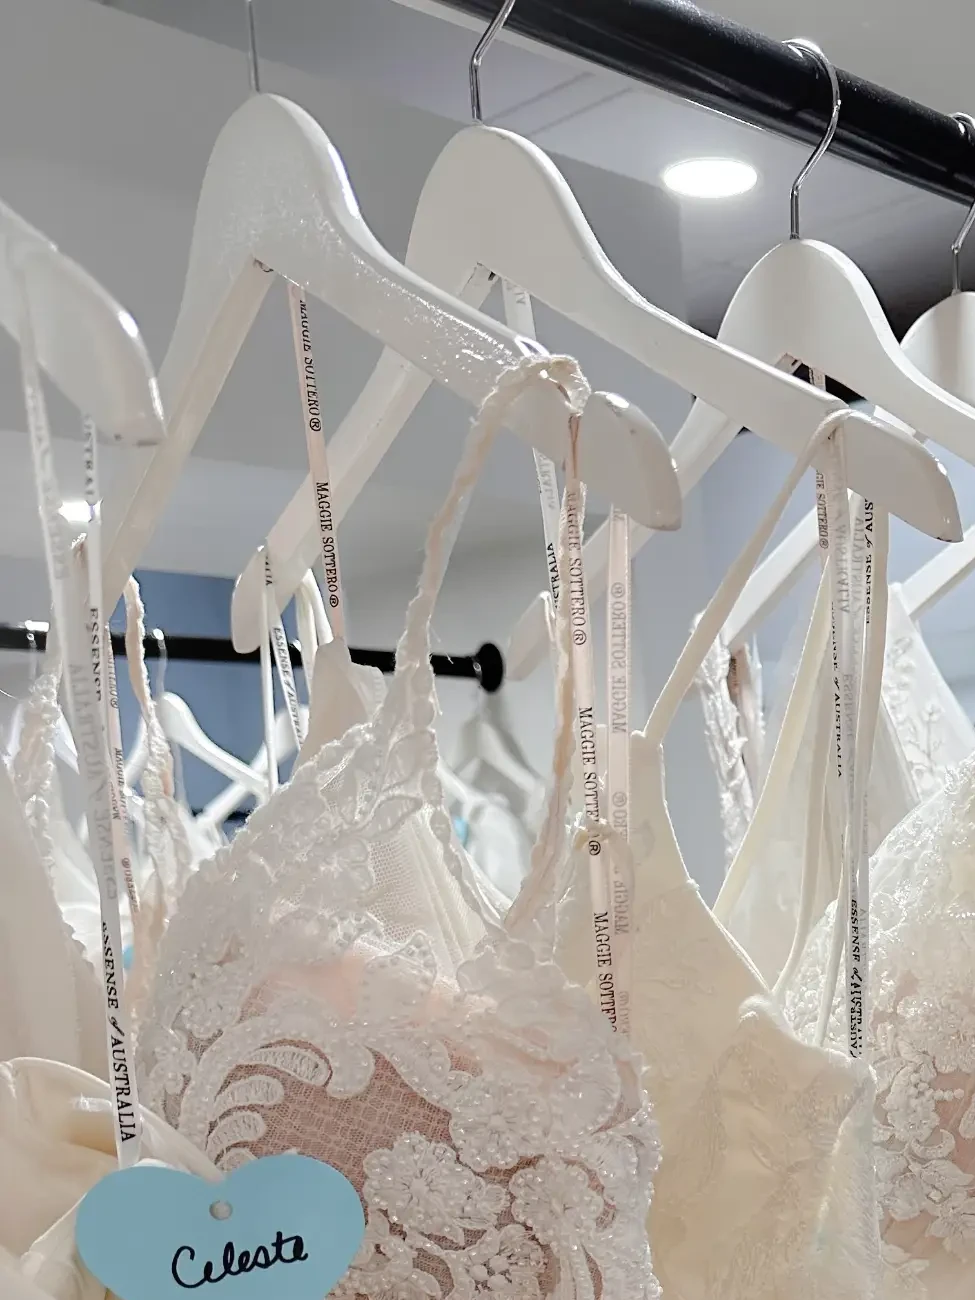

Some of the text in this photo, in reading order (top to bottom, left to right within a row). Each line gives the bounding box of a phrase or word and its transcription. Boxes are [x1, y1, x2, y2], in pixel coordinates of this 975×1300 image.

[316, 482, 340, 608] MAGGIE SOTTERO®
[578, 705, 597, 766] MAGGIE
[594, 911, 613, 967] MAGGIE
[110, 1033, 137, 1143] AUSTRALIA
[171, 1230, 309, 1289] Celeste
